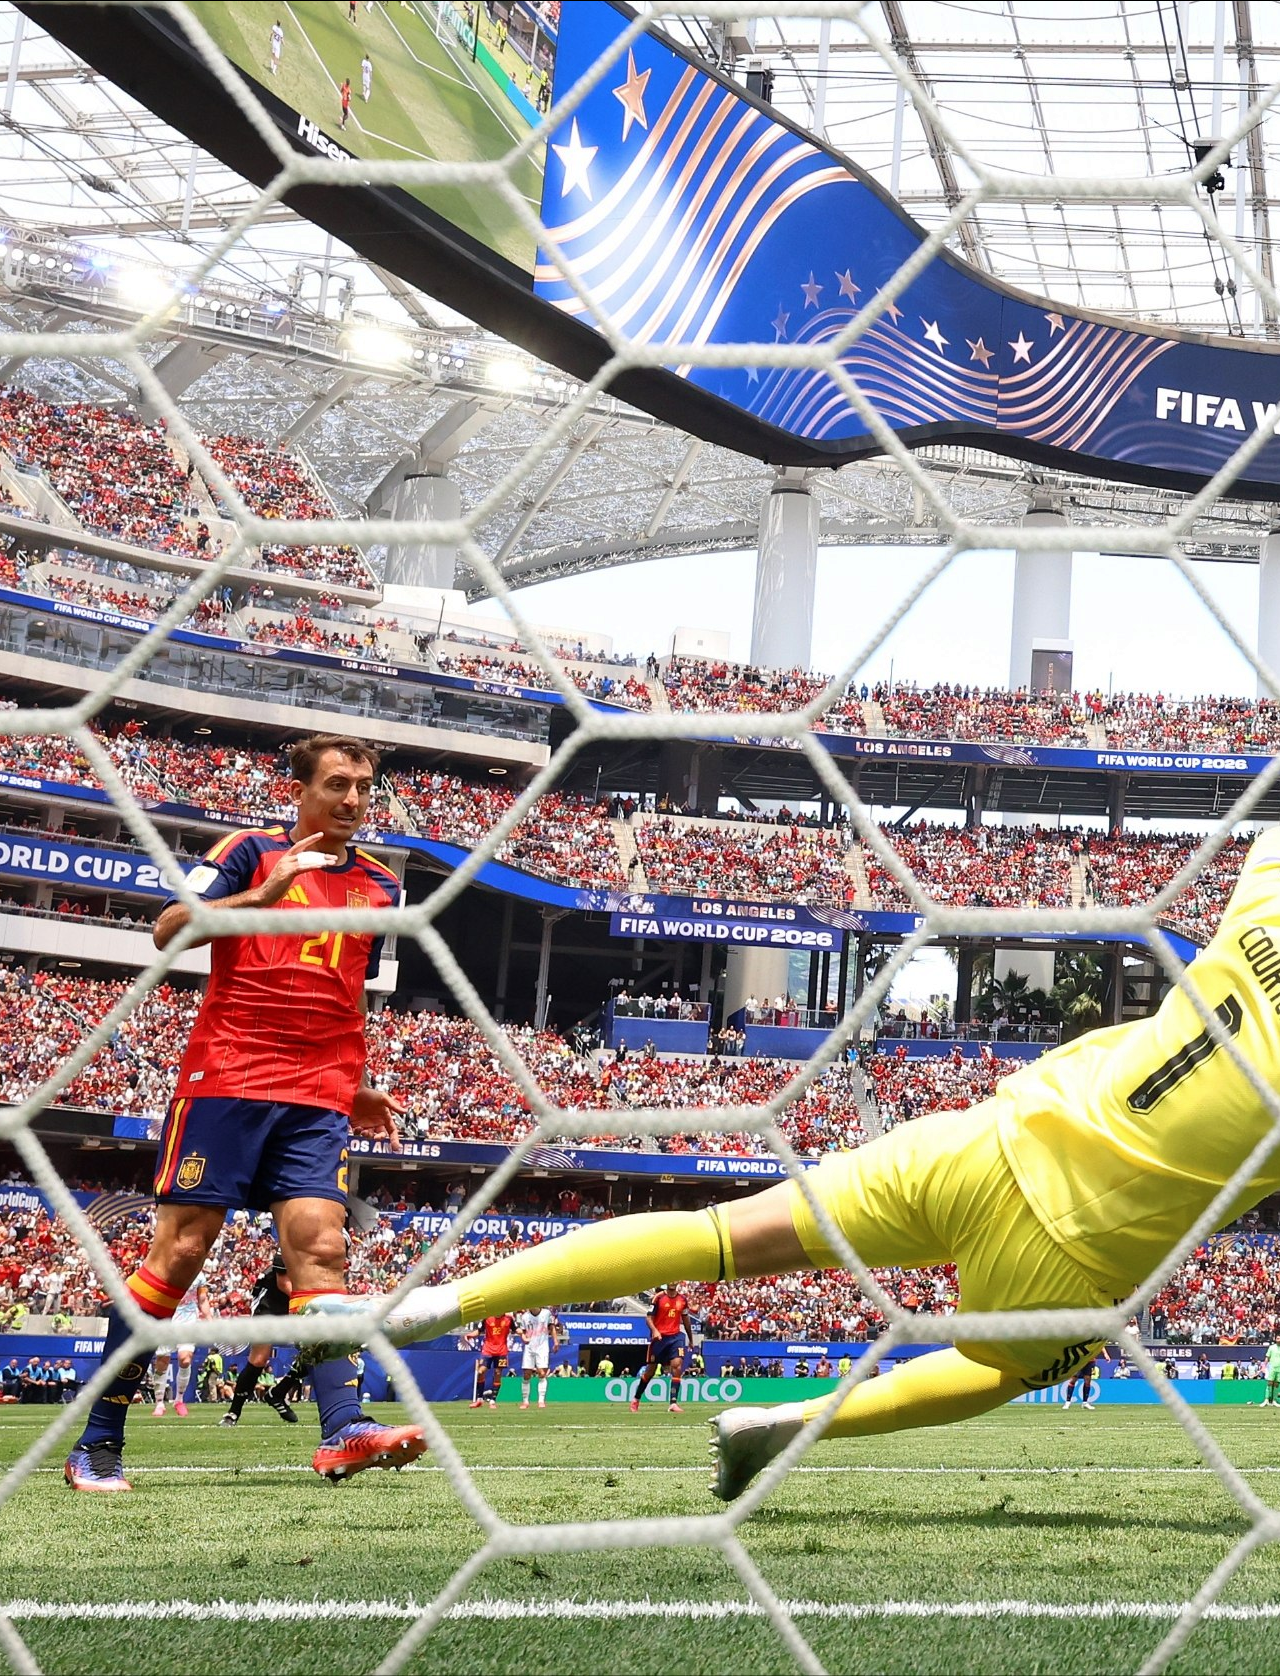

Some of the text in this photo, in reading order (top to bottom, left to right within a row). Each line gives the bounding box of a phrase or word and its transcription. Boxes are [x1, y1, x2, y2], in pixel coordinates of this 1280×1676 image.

[297, 114, 359, 166] Hisen
[1156, 387, 1245, 432] FIFA
[54, 603, 150, 631] FIFA WORLD CUP 2026
[341, 660, 398, 676] LOS ANGELES
[855, 741, 952, 758] LOS ANGELES
[1097, 754, 1249, 771] FIFA WORLD CUP 2026
[8, 776, 42, 789] 2026
[205, 810, 264, 827] LOS ANGELES
[74, 855, 132, 883] CUP
[692, 901, 796, 921] LOS ANGELES
[620, 918, 833, 948] FIFA WORLD CUP 2026
[1126, 993, 1244, 1115] 1
[347, 1139, 441, 1157] OS ANELES
[696, 1160, 726, 1173] FIFA
[727, 1161, 777, 1175] WORLD
[412, 1216, 453, 1234] FIFA
[565, 1322, 592, 1330] WORLD
[592, 1322, 607, 1330] CUP
[74, 1341, 93, 1353] FIFA
[589, 1337, 651, 1346] LOS ANGEL
[1144, 1348, 1192, 1358] ANGELES
